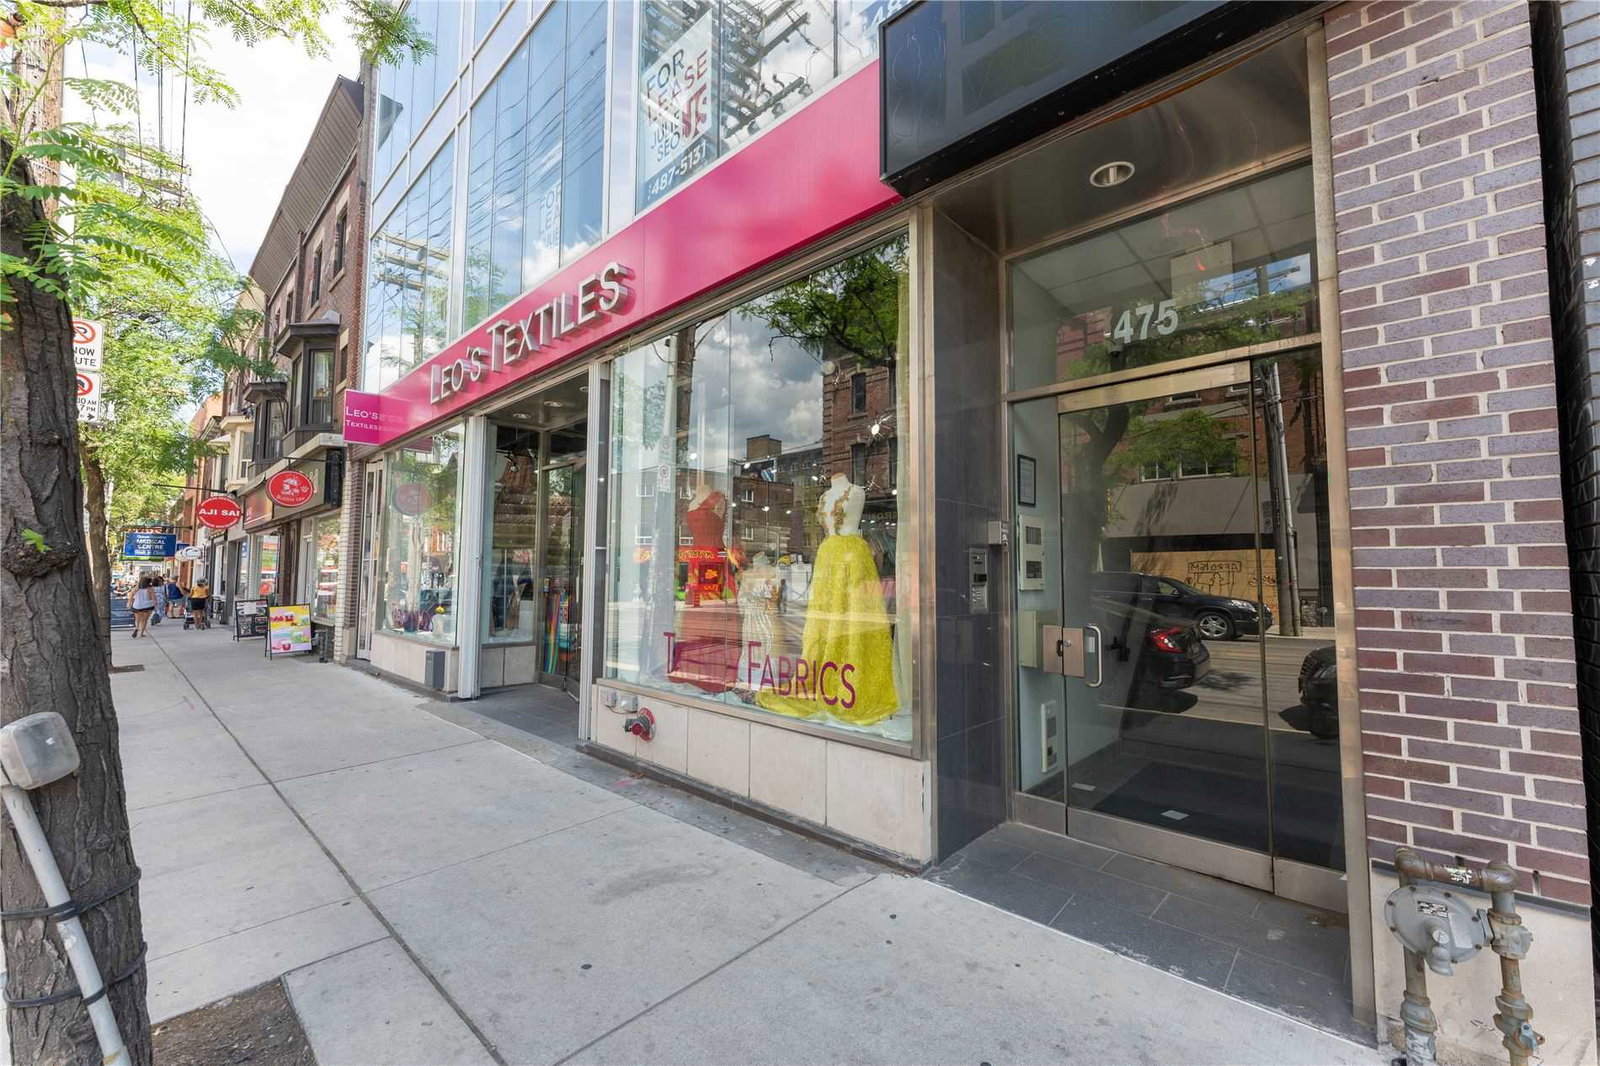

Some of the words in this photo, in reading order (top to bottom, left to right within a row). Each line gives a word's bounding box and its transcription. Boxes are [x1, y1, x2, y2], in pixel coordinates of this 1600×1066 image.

[647, 49, 685, 99] FOR
[648, 50, 707, 122] LEASE
[656, 131, 681, 162] SEO
[431, 346, 489, 404] LEO'S
[486, 261, 628, 373] TEXTILES
[1114, 298, 1179, 344] 475
[74, 347, 95, 357] NOW
[75, 358, 97, 367] UTE
[345, 407, 379, 420] LEO'S
[345, 420, 379, 430] TEXTILES
[221, 509, 240, 517] SAI
[747, 640, 856, 709] FABRICS
